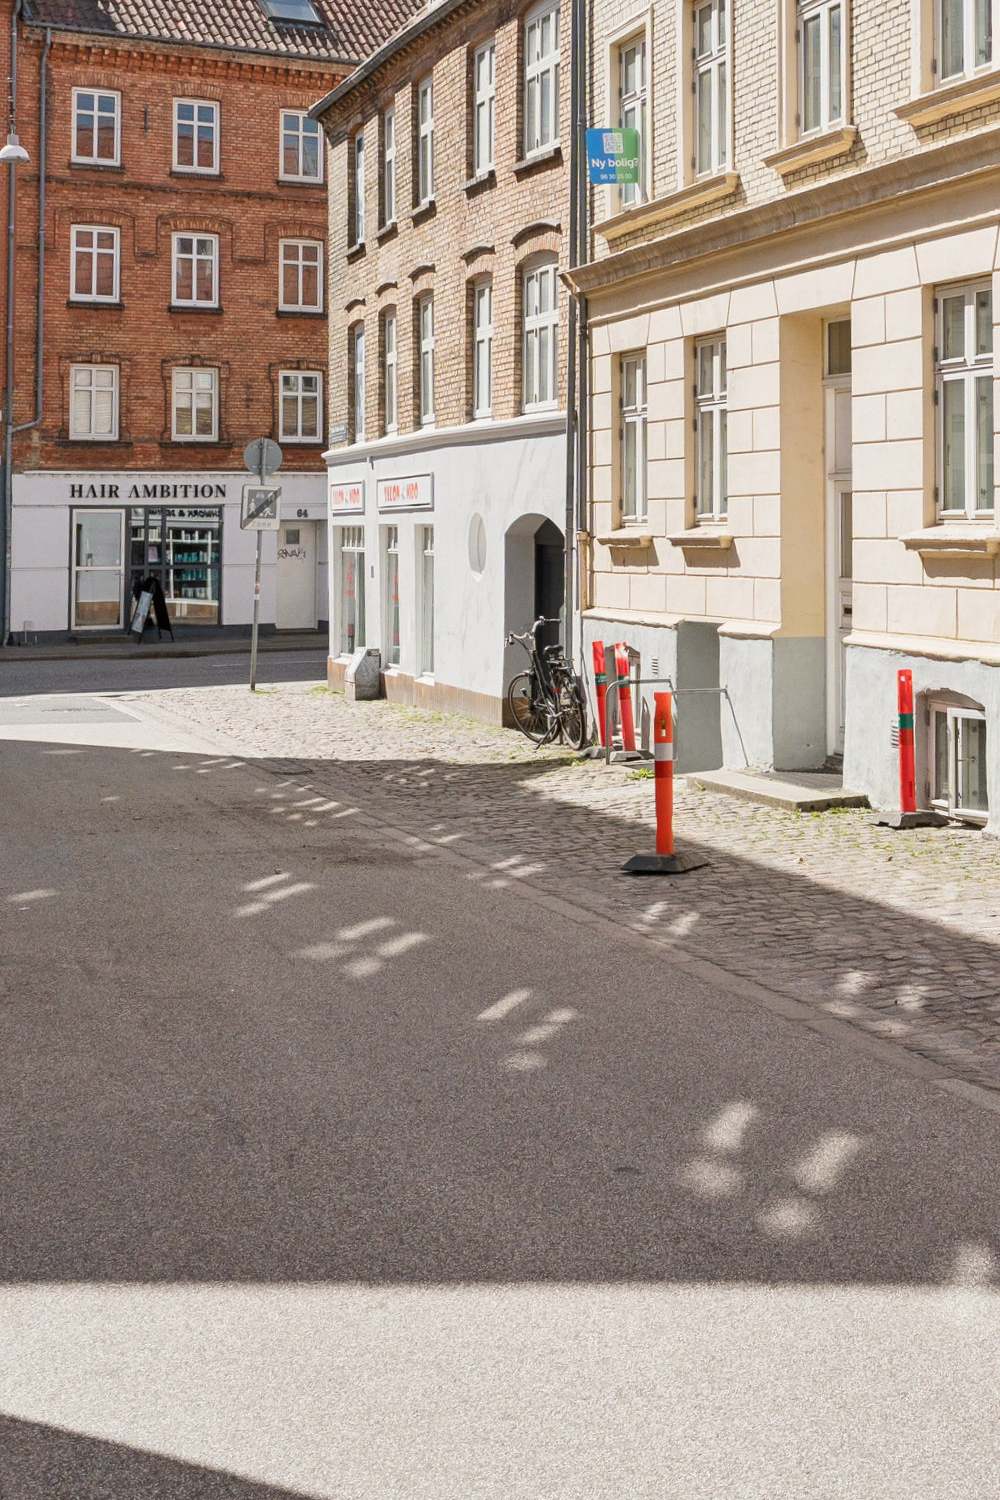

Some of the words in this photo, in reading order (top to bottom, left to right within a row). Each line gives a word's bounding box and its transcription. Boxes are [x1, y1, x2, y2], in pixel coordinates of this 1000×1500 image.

[592, 158, 606, 170] Ny
[608, 157, 638, 169] bolig?
[70, 484, 119, 498] HAIR
[128, 484, 226, 498] AMBITION
[297, 508, 308, 518] 64
